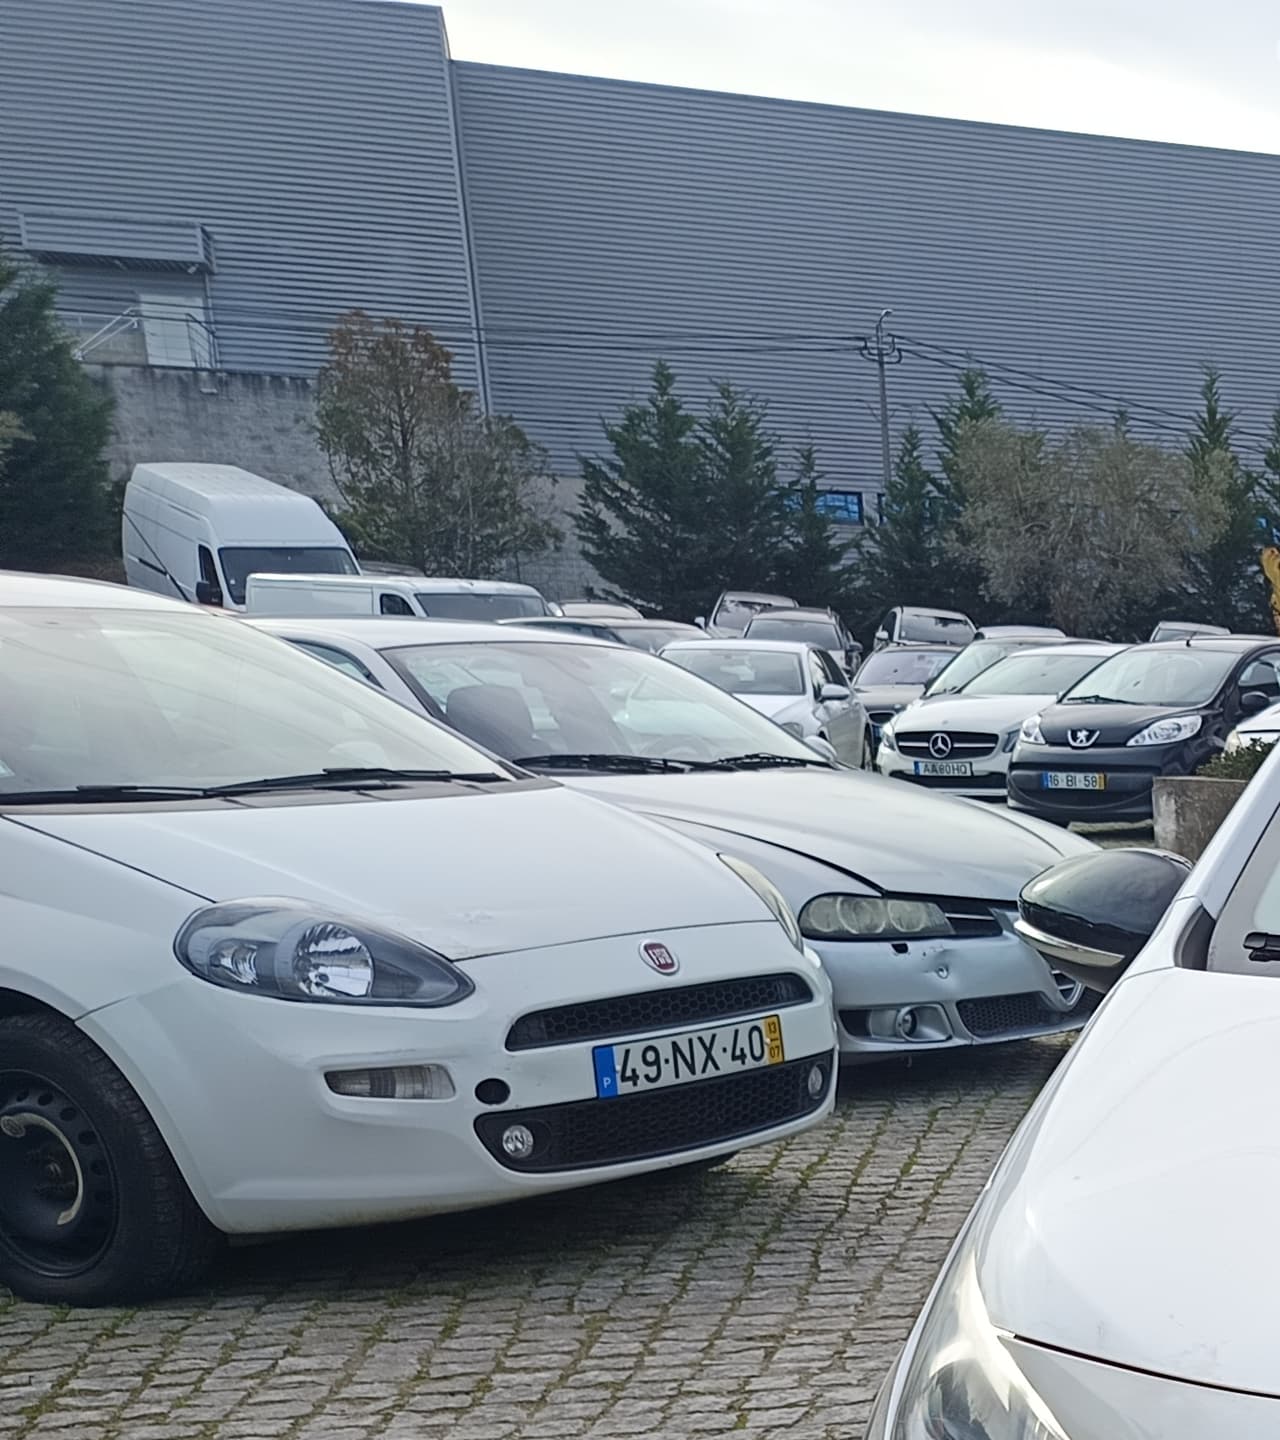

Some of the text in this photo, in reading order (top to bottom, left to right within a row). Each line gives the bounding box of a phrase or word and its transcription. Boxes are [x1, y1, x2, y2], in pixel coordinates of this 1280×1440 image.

[767, 1021, 777, 1035] 13
[769, 1045, 780, 1059] 07
[602, 1076, 612, 1089] P
